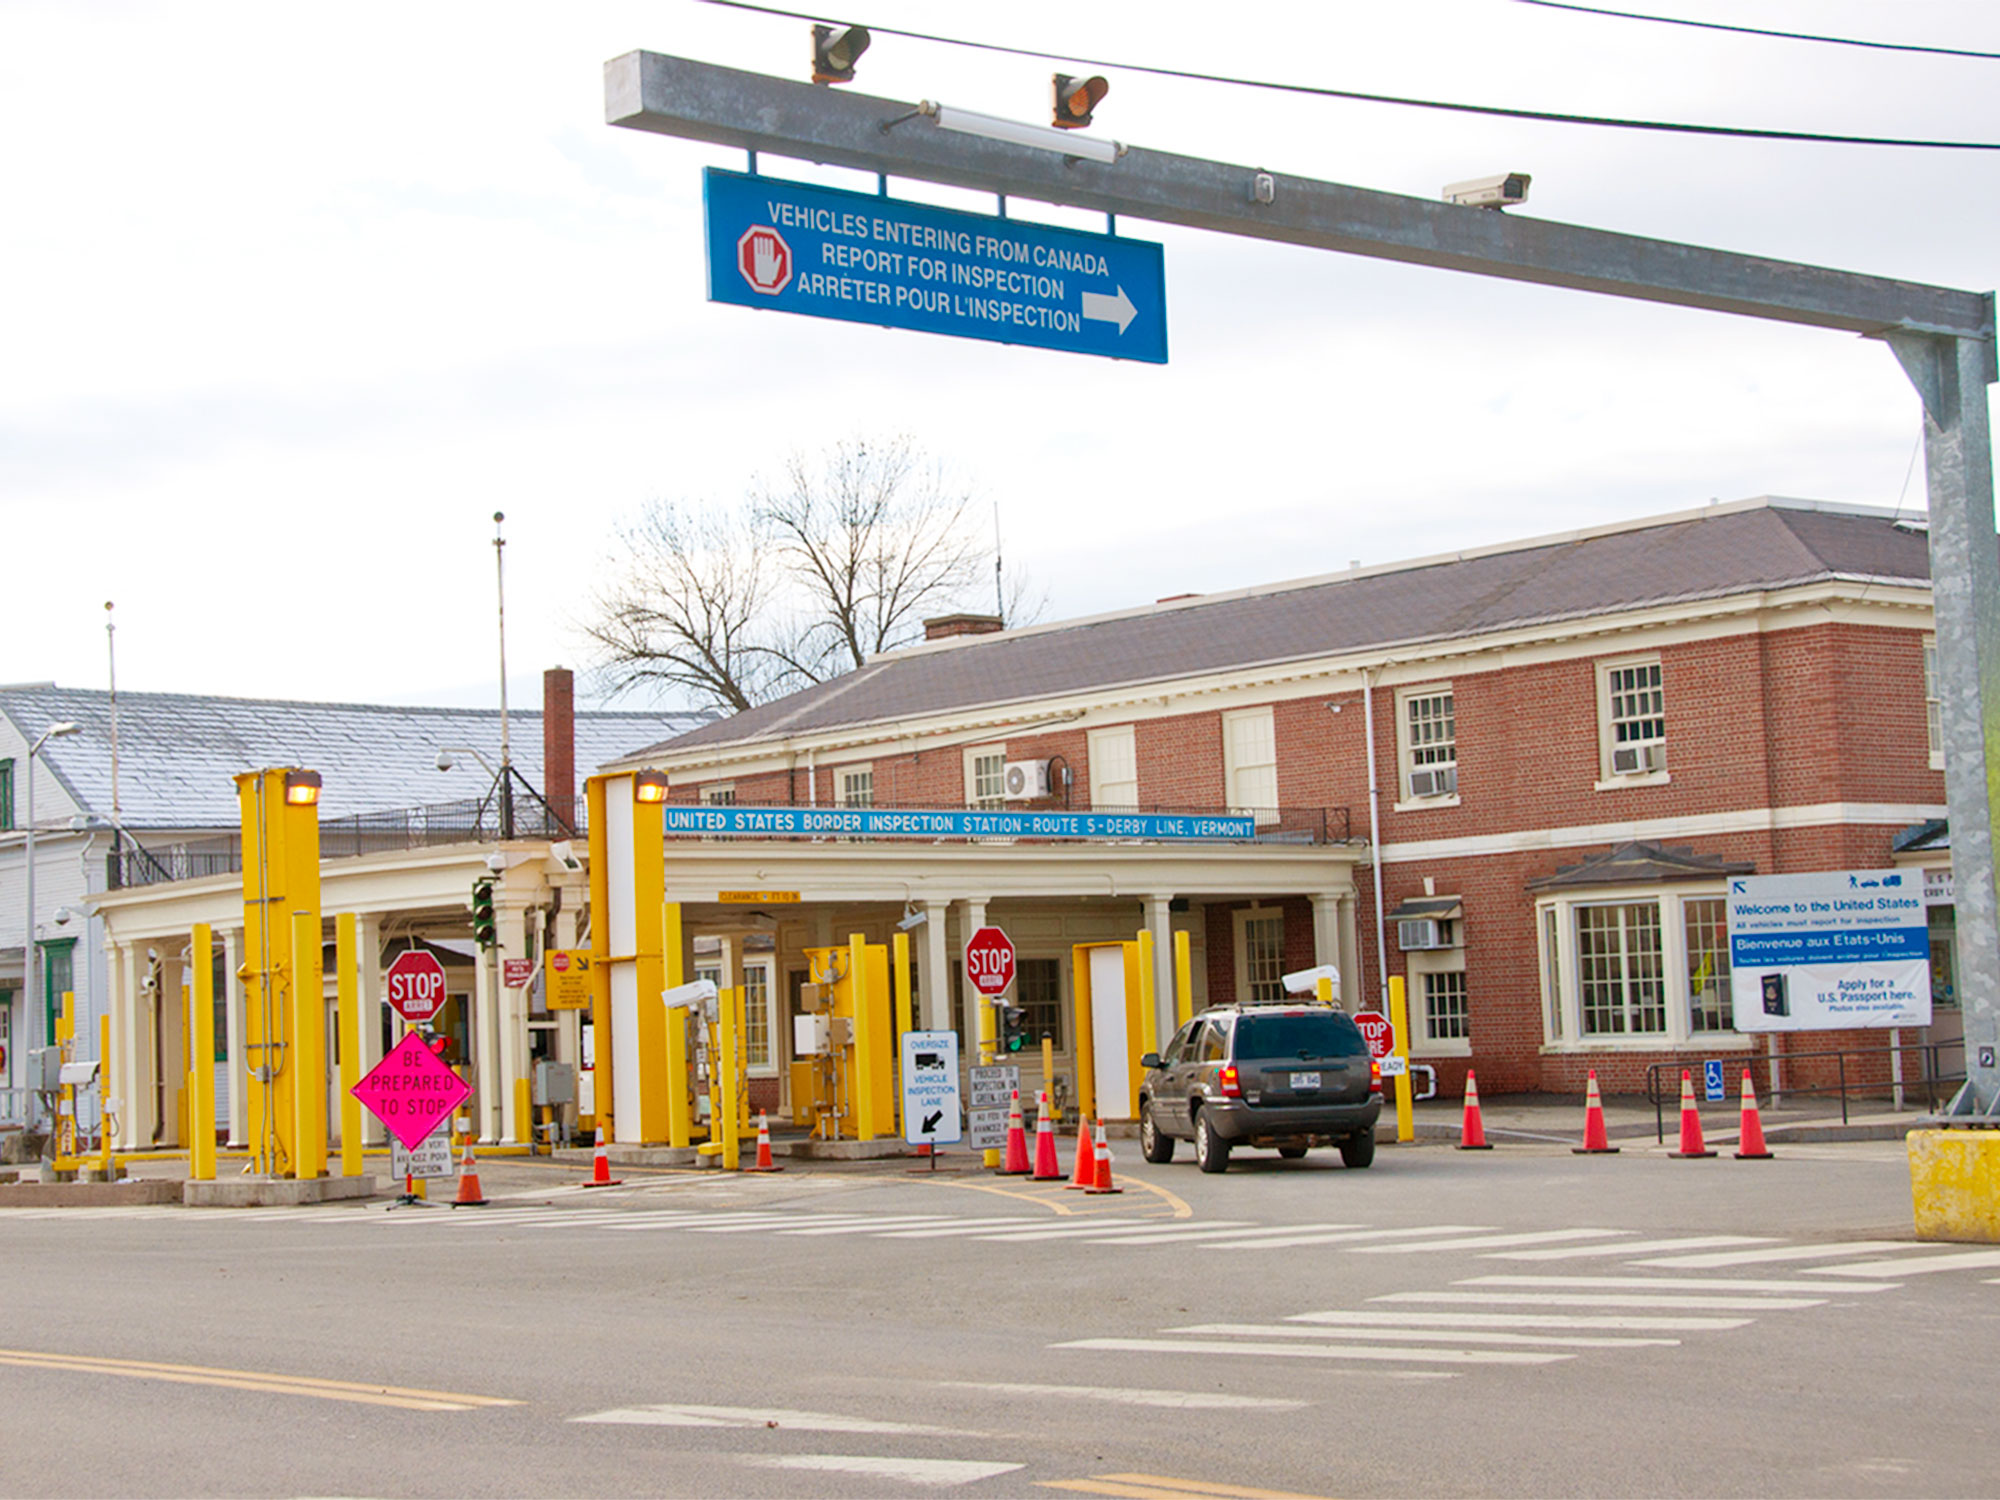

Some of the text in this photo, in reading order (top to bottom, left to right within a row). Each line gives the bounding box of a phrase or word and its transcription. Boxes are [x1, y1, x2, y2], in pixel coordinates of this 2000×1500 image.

[768, 201, 1109, 277] VEHICLES ENTERING FROM CANADA
[823, 243, 1065, 300] REPORT FOR INSPECTION
[896, 286, 950, 314] POUR
[955, 297, 1081, 333] L'INSPECTION
[668, 812, 727, 830] UNITED
[735, 813, 795, 830] STATES
[803, 814, 862, 831] BORDER
[869, 815, 954, 832] INSPECTION
[1193, 820, 1252, 836] VERMONT
[1735, 898, 1919, 916] Welcome to the United States
[1750, 920, 1783, 928] vehicles
[1787, 919, 1807, 927] must
[1811, 918, 1837, 928] report
[1856, 916, 1900, 925] inspection
[1736, 937, 1803, 950] Bienvenue
[1807, 937, 1830, 947] aux
[970, 948, 1011, 974] STOP
[391, 972, 442, 1000] STOP
[1837, 979, 1894, 991] Apply for a
[1817, 990, 1916, 1004] U.S. Passport here.
[1357, 1022, 1387, 1038] TOP
[910, 1040, 949, 1050] OVERSIZE
[403, 1051, 422, 1067] BE
[1381, 1061, 1402, 1071] EADY
[371, 1075, 454, 1091] PREPARED
[914, 1074, 947, 1084] VEHICLE
[908, 1085, 955, 1095] INSPECTION
[381, 1098, 447, 1115] TO STOP
[921, 1097, 942, 1106] LANE
